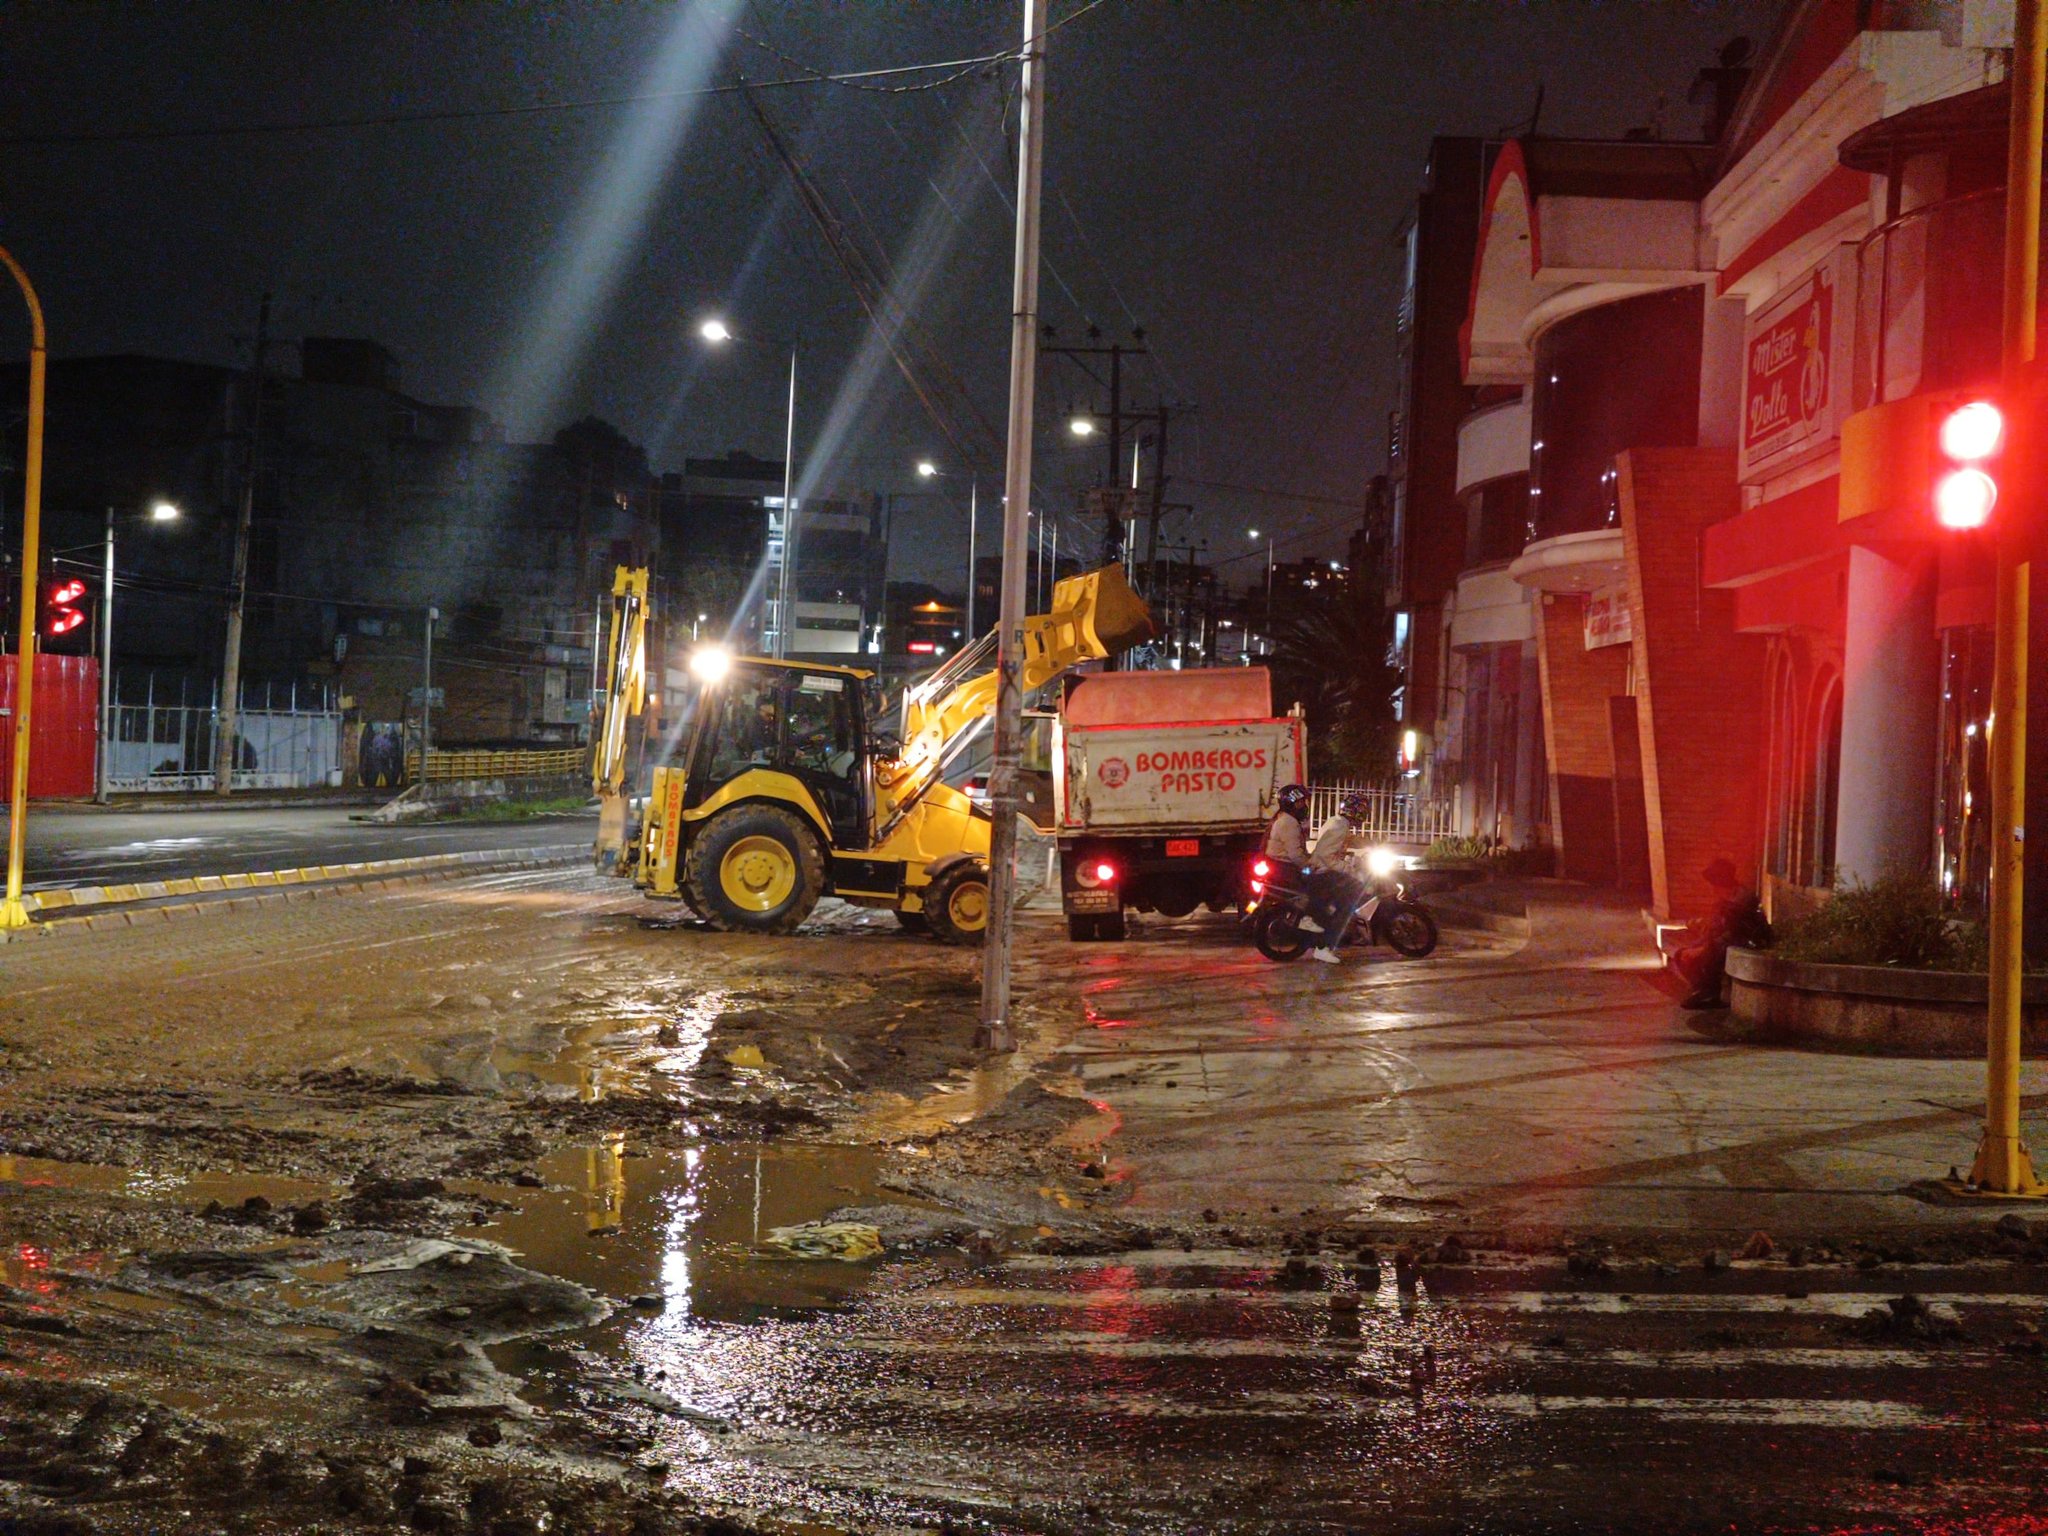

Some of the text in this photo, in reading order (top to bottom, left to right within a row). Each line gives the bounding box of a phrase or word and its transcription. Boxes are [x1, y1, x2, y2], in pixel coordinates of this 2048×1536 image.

[1753, 327, 1797, 375] Mister
[1750, 379, 1789, 432] Pollo
[1136, 748, 1267, 773] BOMBEROS
[1162, 772, 1236, 794] PASTO
[665, 783, 679, 857] BOMBEROS
